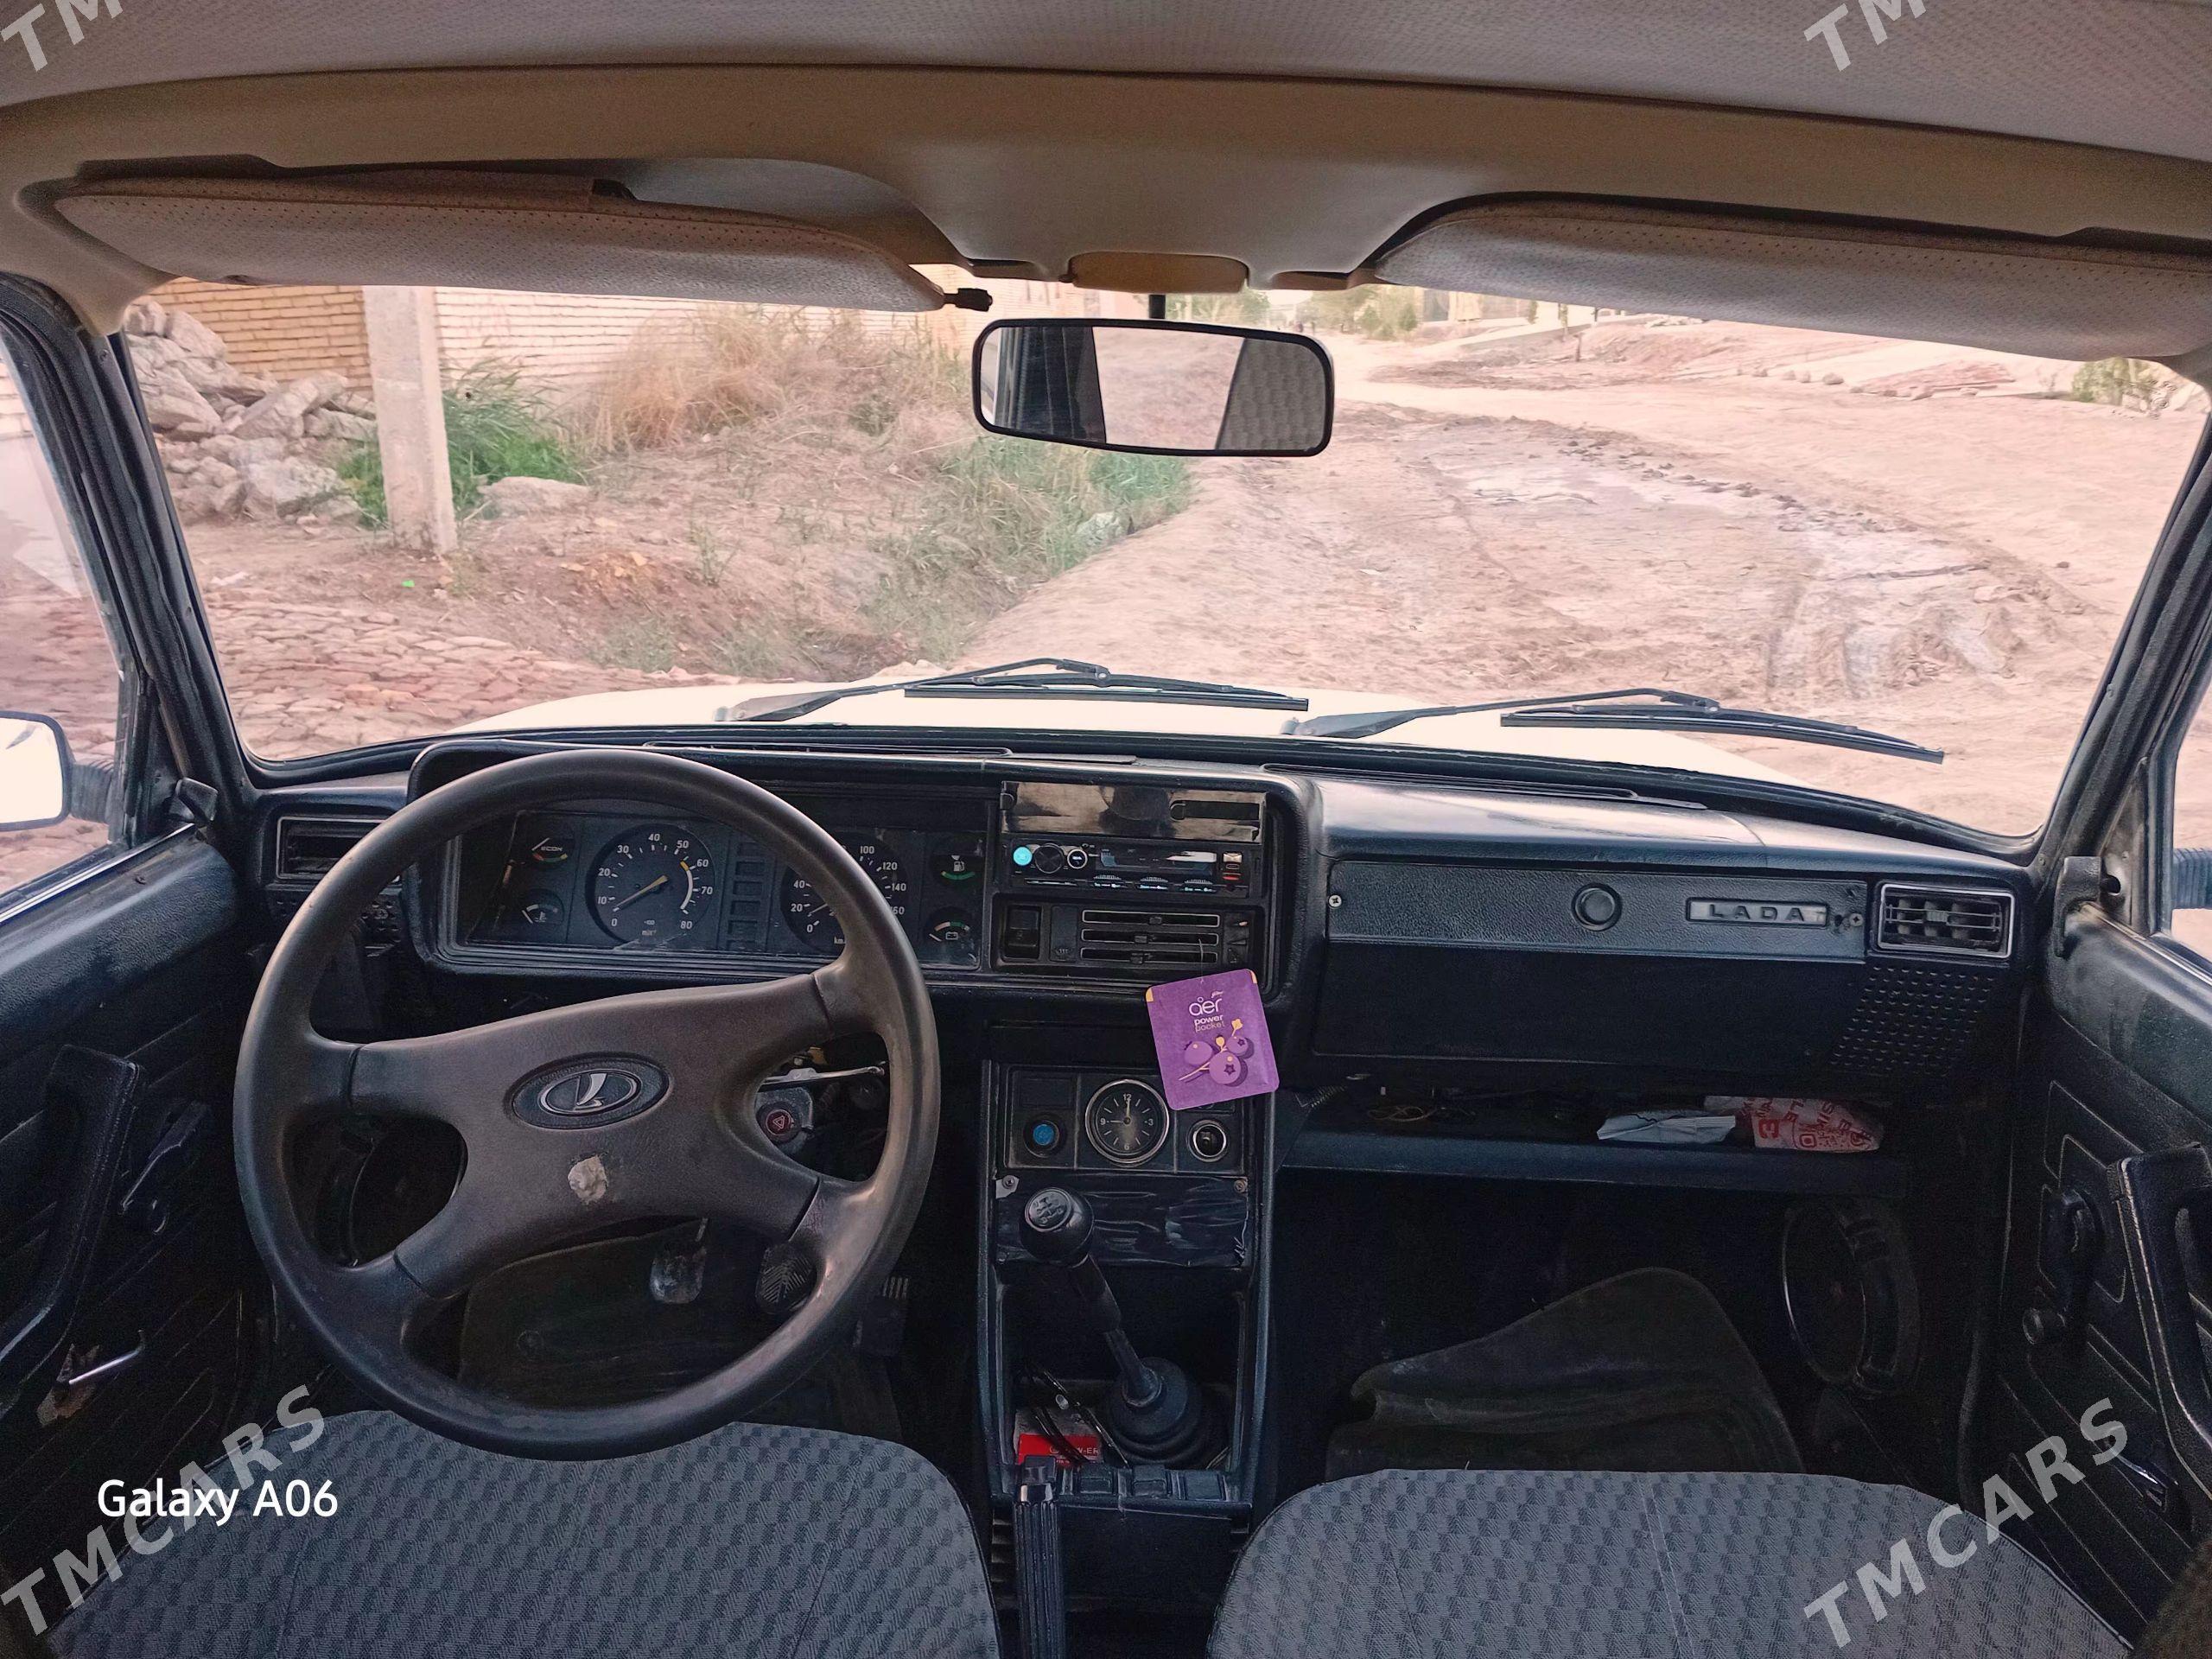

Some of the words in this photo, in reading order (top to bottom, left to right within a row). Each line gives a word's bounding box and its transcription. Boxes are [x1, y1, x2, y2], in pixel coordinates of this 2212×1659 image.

[648, 833, 660, 842] 40
[677, 840, 690, 849] 50
[617, 845, 629, 854] 30
[696, 859, 709, 868] 60
[882, 862, 898, 871] 120
[598, 868, 611, 876] 20
[793, 880, 805, 889] 40
[891, 882, 906, 892] 140
[701, 886, 714, 895] 70
[597, 896, 607, 905] 10
[791, 903, 803, 912] 20
[1707, 903, 1806, 923] LADA
[611, 918, 618, 927] 0
[680, 920, 693, 930] 80
[806, 924, 813, 932] 0
[1194, 1014, 1224, 1028] power
[1122, 1093, 1132, 1102] 12
[1100, 1117, 1106, 1126] 9
